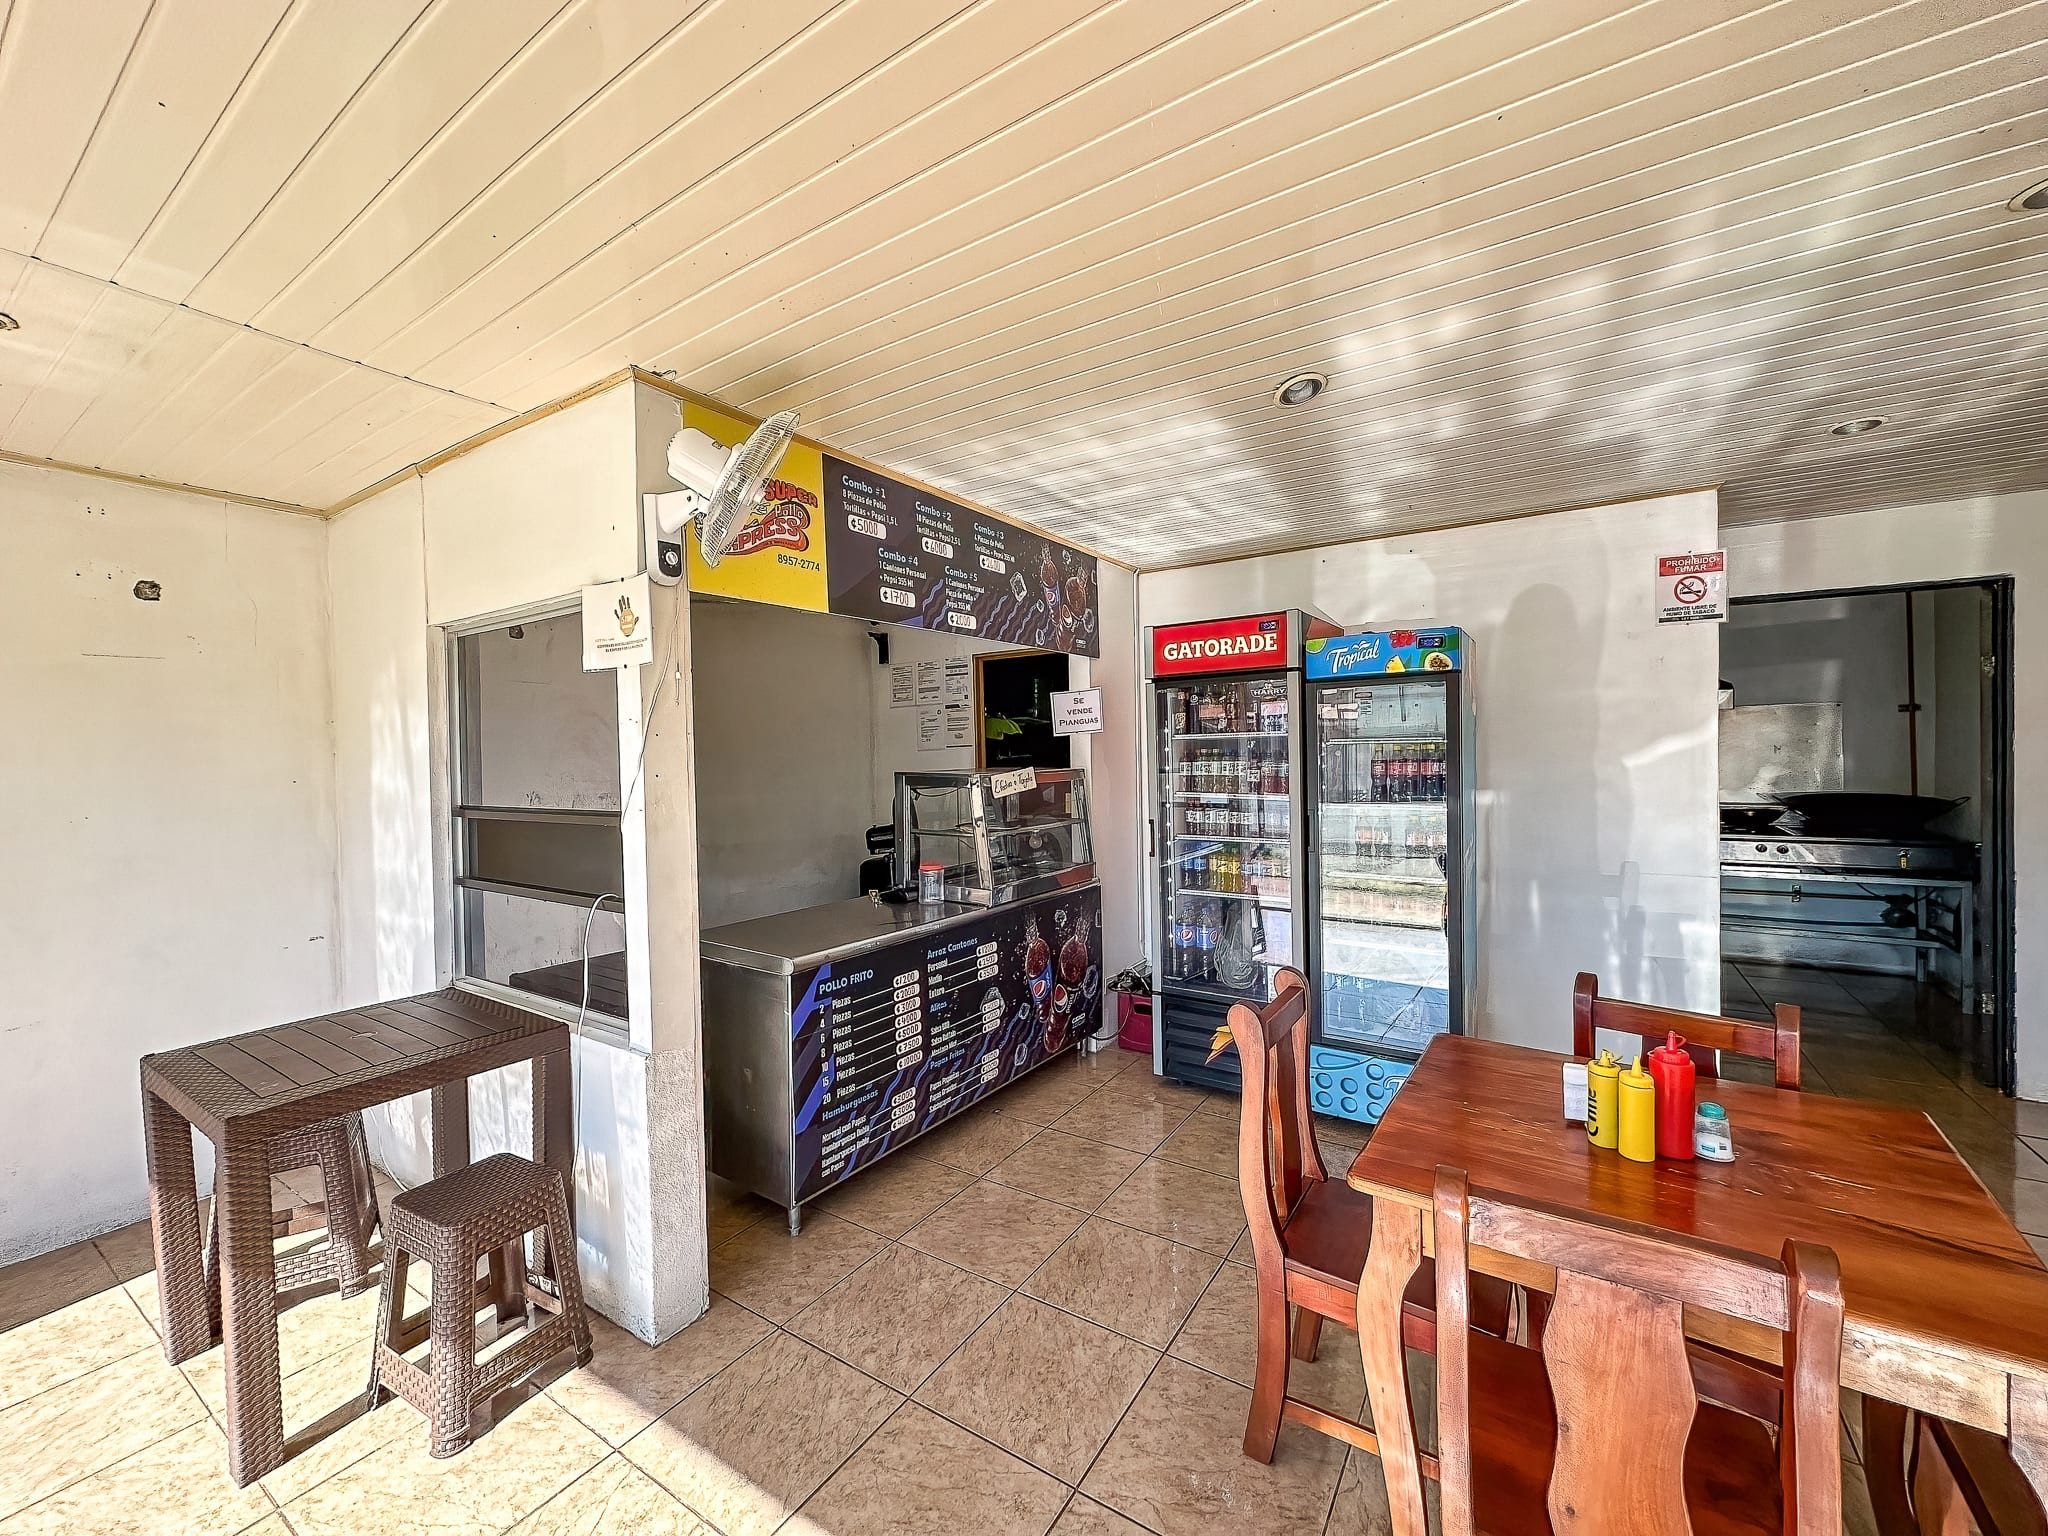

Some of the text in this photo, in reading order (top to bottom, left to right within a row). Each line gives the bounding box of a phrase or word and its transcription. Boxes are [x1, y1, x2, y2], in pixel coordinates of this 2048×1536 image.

[764, 479, 818, 508] SUPER
[842, 475, 872, 494] Combo
[847, 490, 865, 504] Piezas
[865, 497, 872, 506] de
[873, 499, 887, 510] Pollo
[915, 501, 940, 517] Combo
[774, 504, 803, 520] Pollo
[843, 501, 866, 515] Tortillas
[871, 510, 886, 522] Pepsi
[730, 518, 799, 551] PRESS
[938, 532, 951, 542] Pepsi
[974, 522, 995, 536] Combo
[777, 553, 820, 572] 8957-2774
[878, 548, 907, 563] Combo
[1666, 556, 1716, 568] PROHIBIDO
[906, 567, 927, 580] Personal
[945, 565, 968, 579] Combo
[1674, 564, 1706, 573] FUMAR
[883, 573, 897, 584] Pepsi
[1163, 633, 1278, 661] GATORADE
[1326, 638, 1380, 674] Tropical
[1066, 707, 1093, 716] VENDE
[1059, 717, 1098, 727] PIANGUAS
[927, 937, 978, 960] Arroz Cantones
[820, 969, 874, 995] POLLO FRITO
[820, 1004, 824, 1014] 2
[832, 996, 851, 1010] Piezas
[820, 1018, 825, 1028] 4
[832, 1010, 852, 1024] Piezas
[820, 1033, 825, 1043] 6
[832, 1025, 852, 1039] Piezas
[820, 1048, 825, 1058] 8
[833, 1039, 852, 1053] Piezas
[821, 1061, 828, 1073] 10
[835, 1052, 855, 1067] Piezas
[822, 1076, 829, 1087] 15
[836, 1066, 856, 1081] Piezas
[823, 1093, 831, 1105] 20
[837, 1083, 856, 1099] Piezas
[822, 1089, 879, 1121] Hamburguesas
